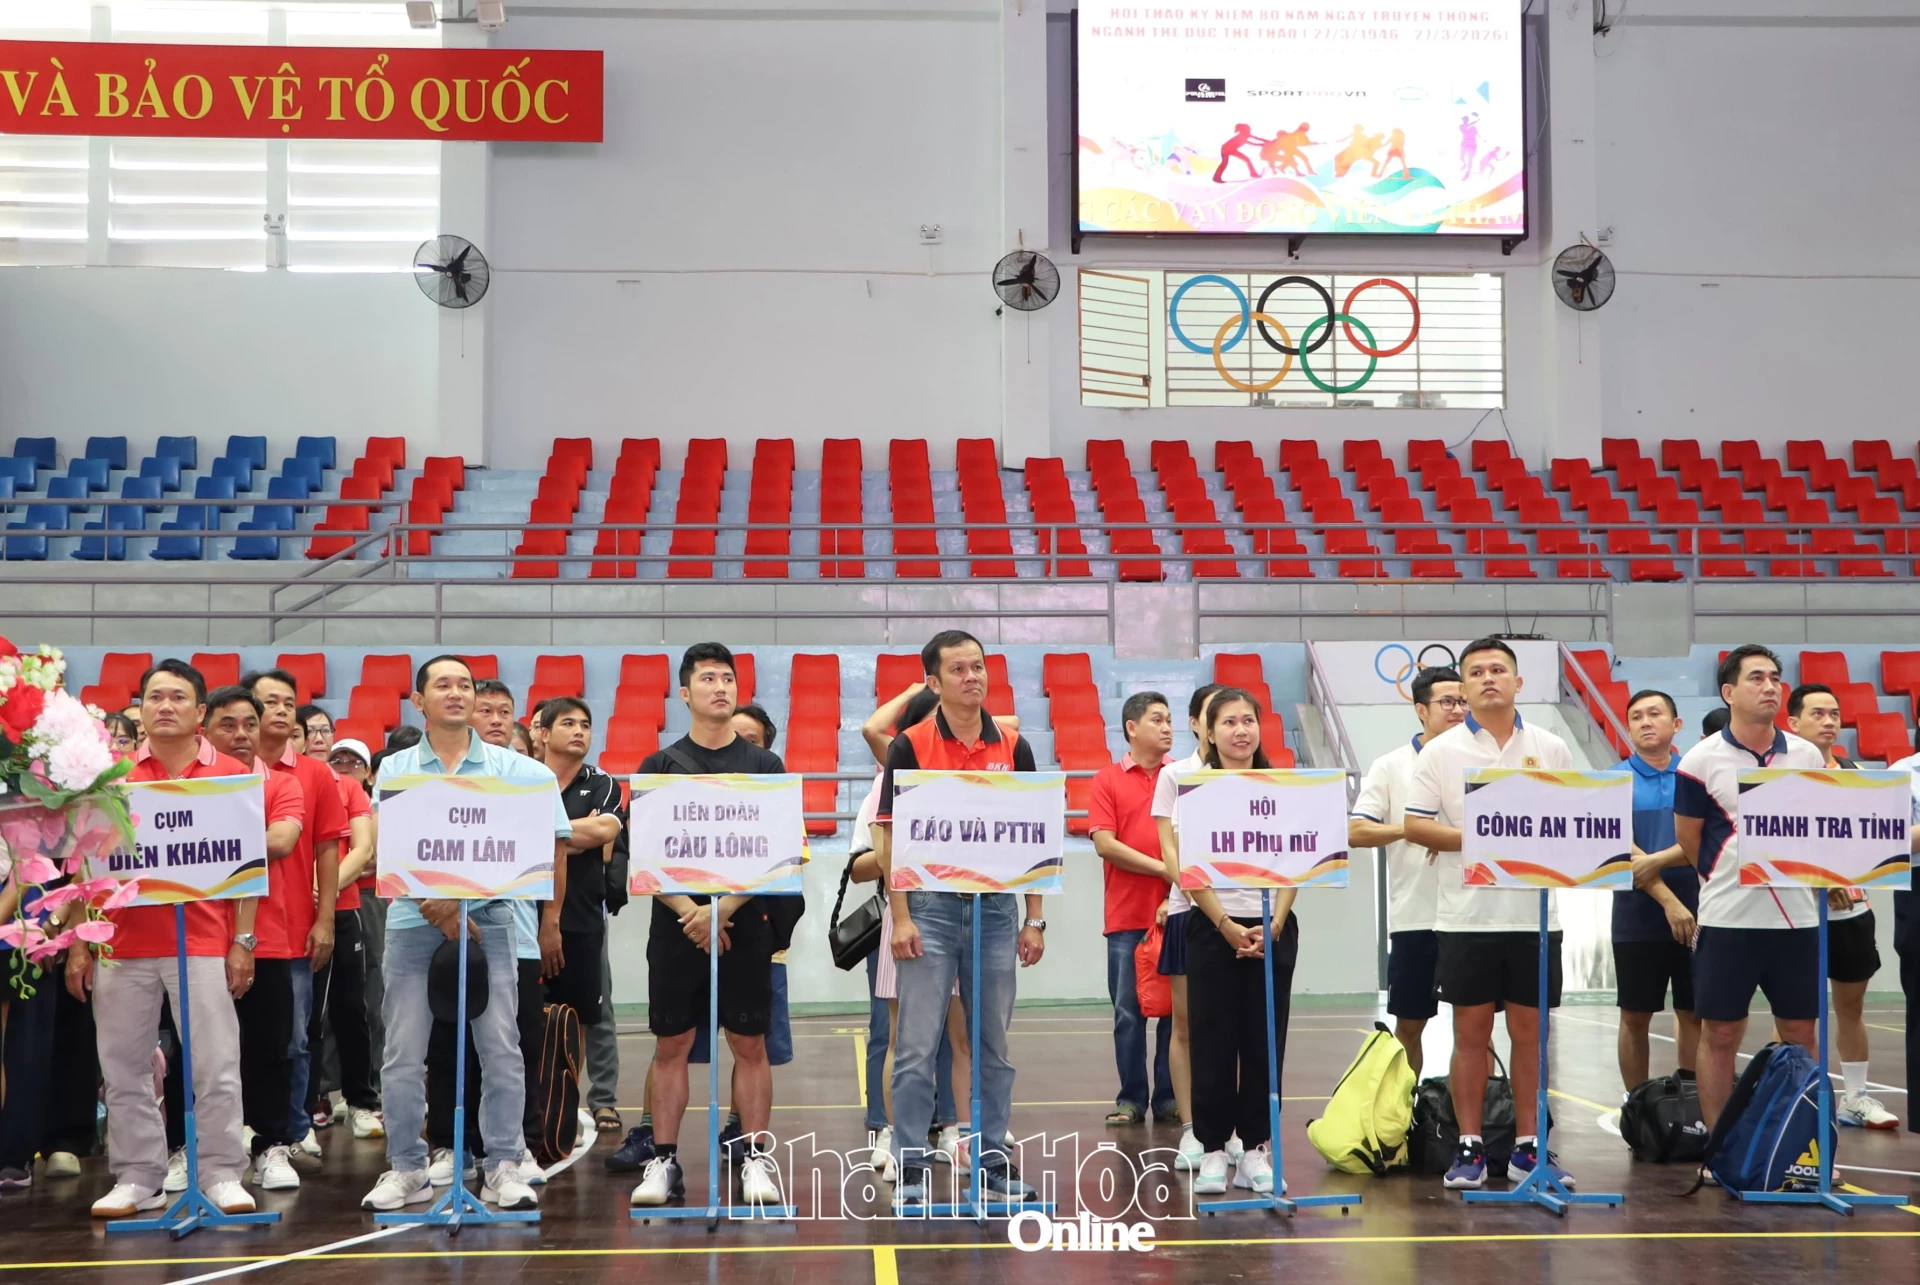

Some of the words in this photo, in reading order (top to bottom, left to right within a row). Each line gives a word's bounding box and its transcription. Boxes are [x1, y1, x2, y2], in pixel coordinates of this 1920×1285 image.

[1259, 9, 1280, 21] 80
[0, 57, 79, 118] VÀ
[95, 58, 214, 120] BẢO
[229, 62, 303, 133] VỆ
[319, 53, 396, 122] TỔ
[410, 57, 570, 132] QUỐC
[154, 810, 194, 832] CỤM
[449, 807, 486, 828] CỤM
[673, 801, 710, 821] LIÊN
[714, 801, 760, 821] ĐOÀN
[1249, 796, 1276, 821] HỘI
[910, 816, 953, 842] BÁO
[959, 816, 987, 842] VÀ
[994, 820, 1046, 844] PTTH
[1476, 812, 1533, 838] CÔNG
[1539, 815, 1567, 838] AN
[1573, 811, 1621, 839] TỈNH
[1743, 814, 1809, 838] THANH
[1815, 816, 1853, 839] TRA
[1859, 812, 1905, 840] TỈNH
[167, 837, 242, 867] KHÁNH
[417, 838, 465, 861] CAM
[472, 836, 516, 862] LÂM
[664, 828, 707, 858] CẦU
[715, 832, 769, 858] LÔNG
[1211, 832, 1235, 853] LH
[1243, 831, 1282, 857] Phụ
[1289, 831, 1319, 853] nữ
[1784, 1164, 1820, 1177] JOOL
